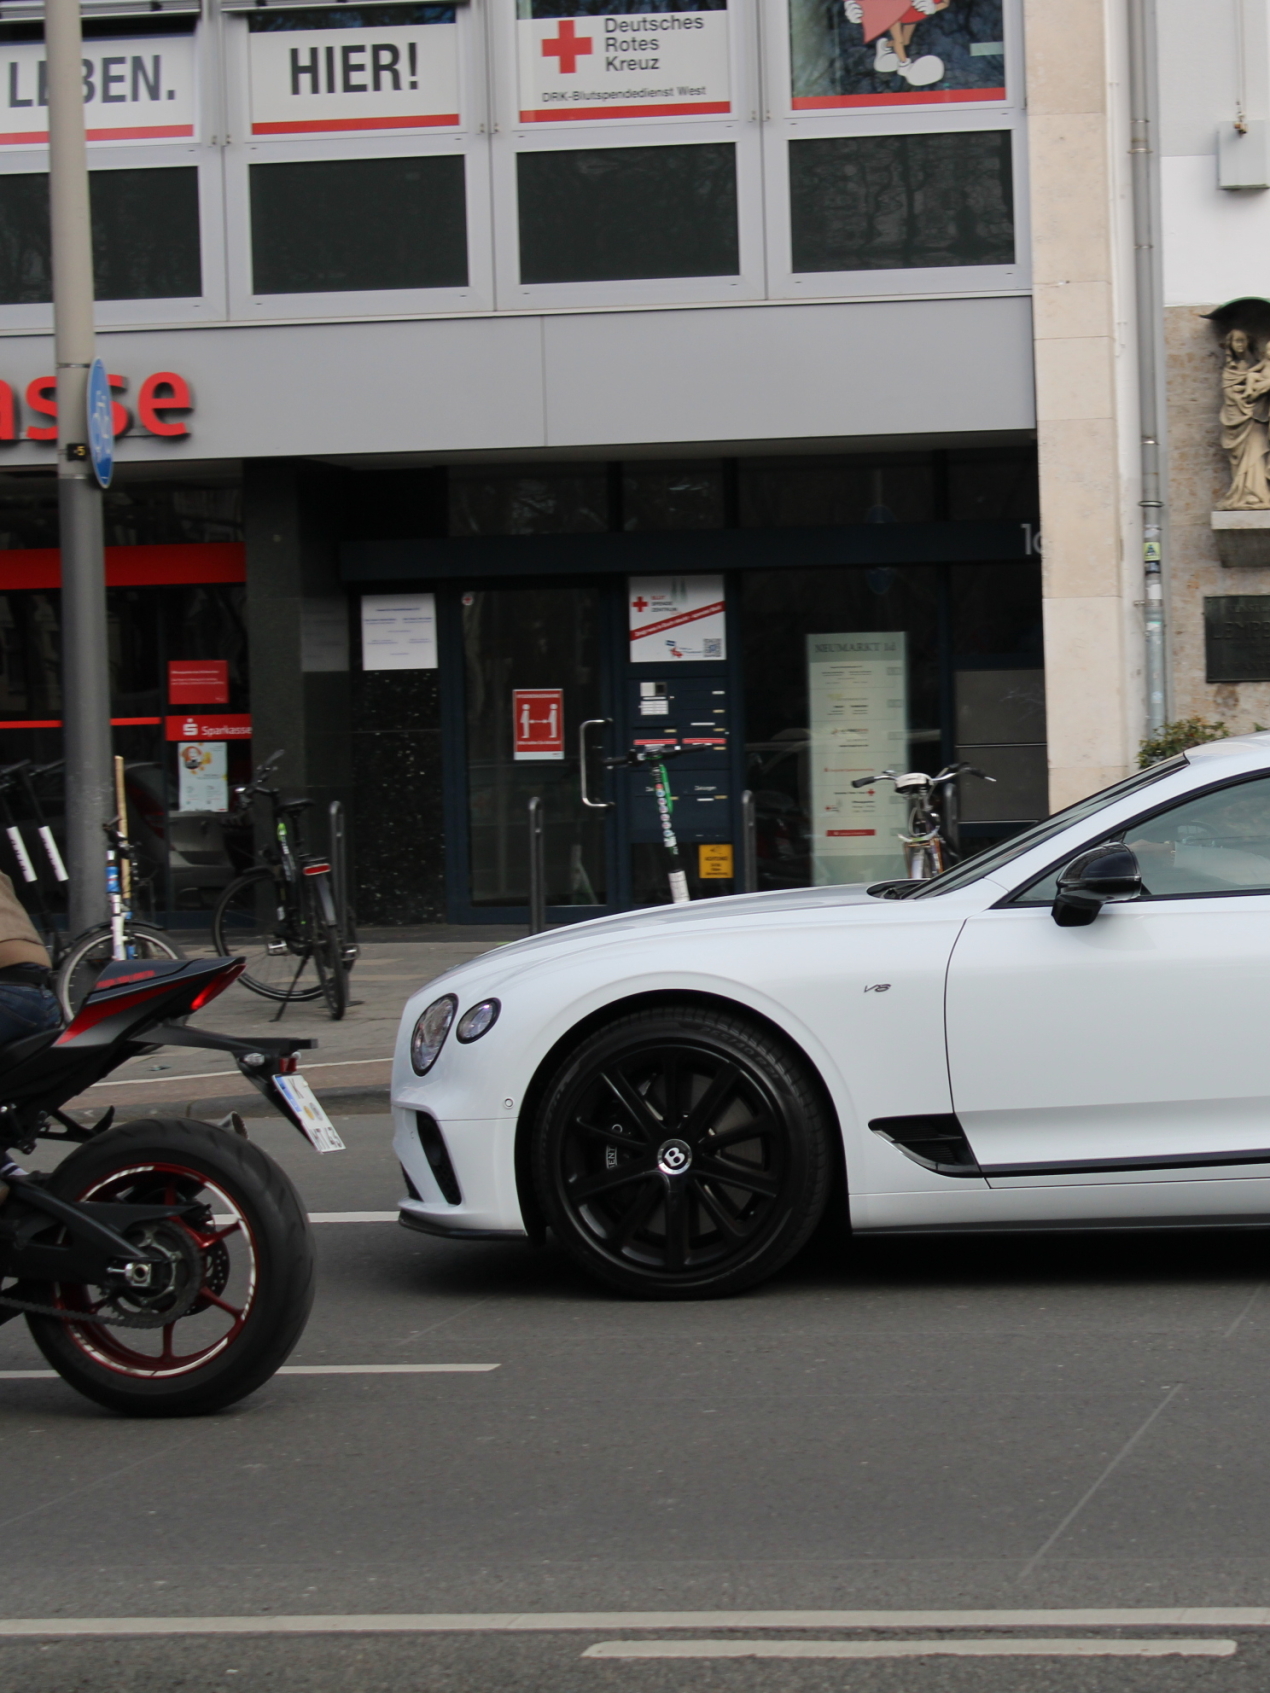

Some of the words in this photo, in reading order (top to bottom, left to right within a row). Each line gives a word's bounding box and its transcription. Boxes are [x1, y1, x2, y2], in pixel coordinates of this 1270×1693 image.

[604, 15, 704, 34] Deutsches
[604, 36, 660, 53] Rotes
[289, 42, 419, 96] HIER!
[605, 56, 660, 72] Kreuz
[541, 87, 674, 103] DRK-Blutspendedienst
[677, 85, 706, 97] West
[201, 725, 253, 738] Sparkasse
